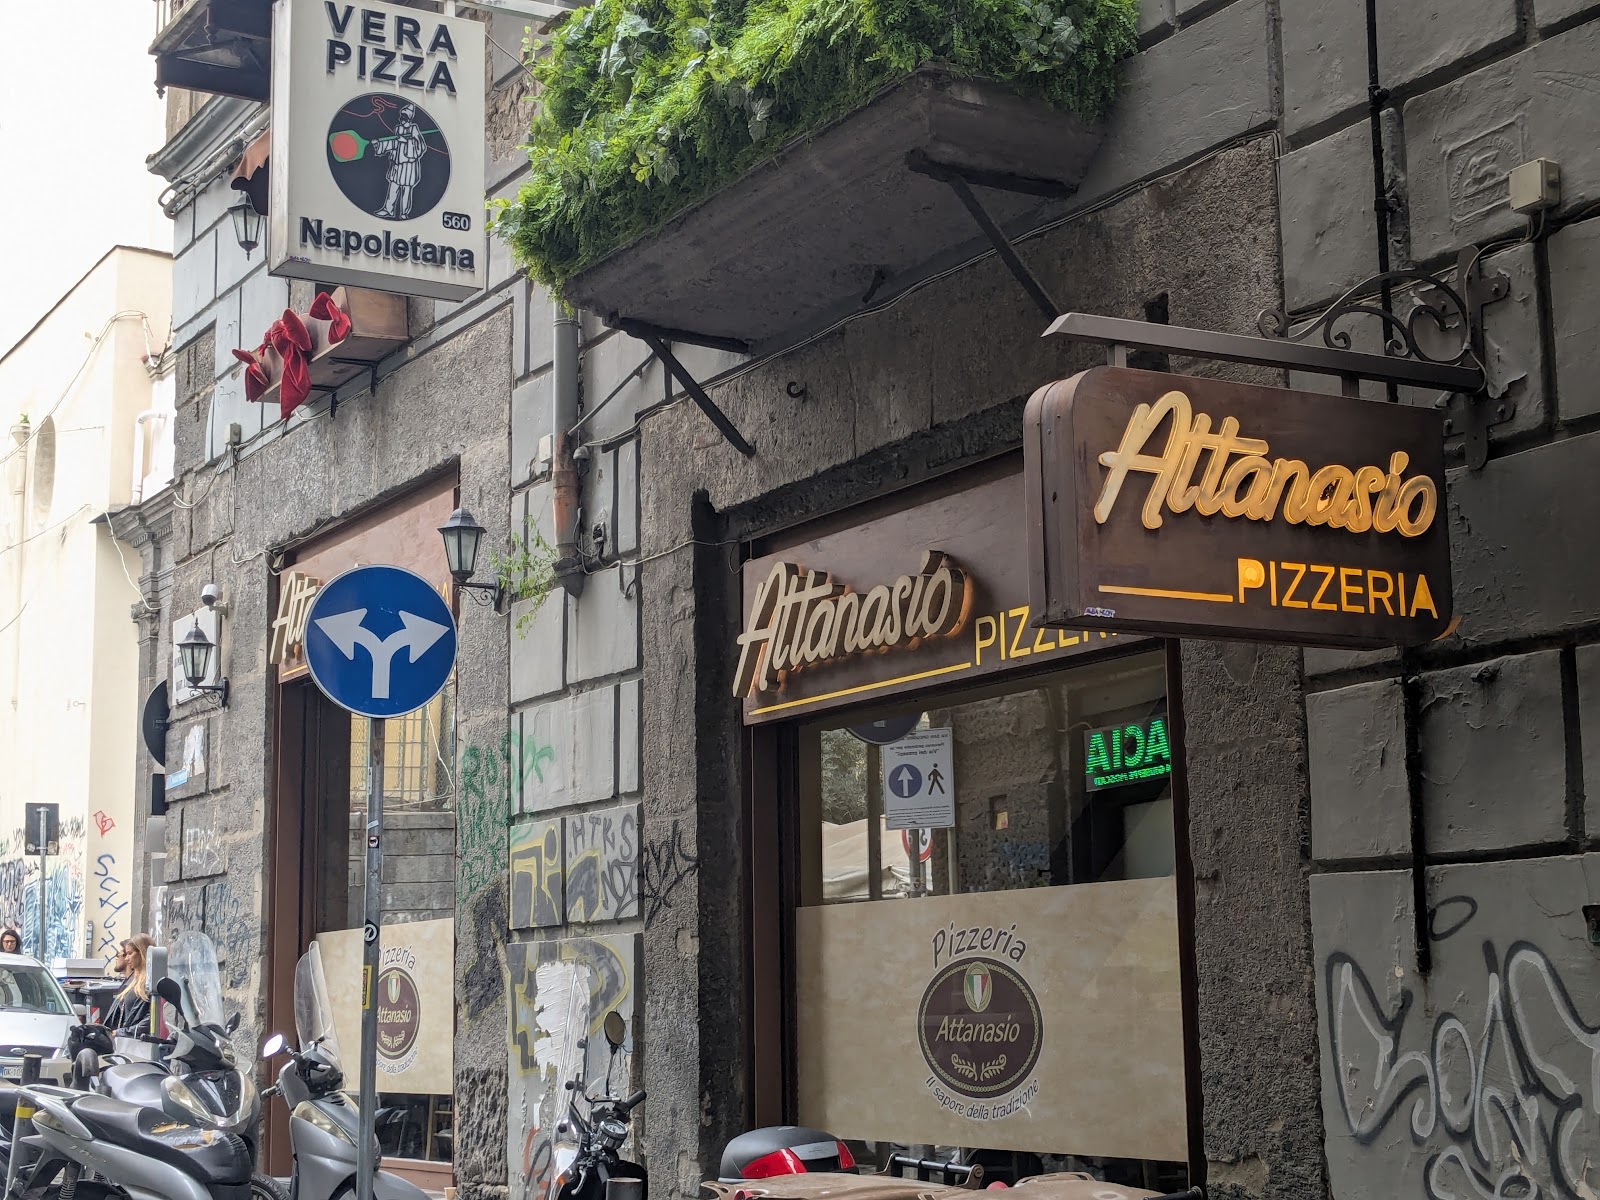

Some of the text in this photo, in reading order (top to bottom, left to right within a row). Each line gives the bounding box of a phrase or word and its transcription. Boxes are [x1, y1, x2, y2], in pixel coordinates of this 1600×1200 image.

[324, 0, 457, 60] VERA
[326, 39, 457, 96] PIZZA
[299, 216, 475, 272] Napoletana
[443, 214, 469, 230] 560
[1093, 390, 1438, 538] Attanasio
[1237, 557, 1439, 619] PIZZERIA
[732, 549, 966, 698] Attanasio
[379, 944, 416, 970] izzeria
[932, 922, 1027, 968] Pizzeria
[935, 1014, 1020, 1042] Attanasio
[933, 1087, 964, 1115] sapore
[966, 1104, 989, 1120] della
[992, 1079, 1039, 1120] tradizione
